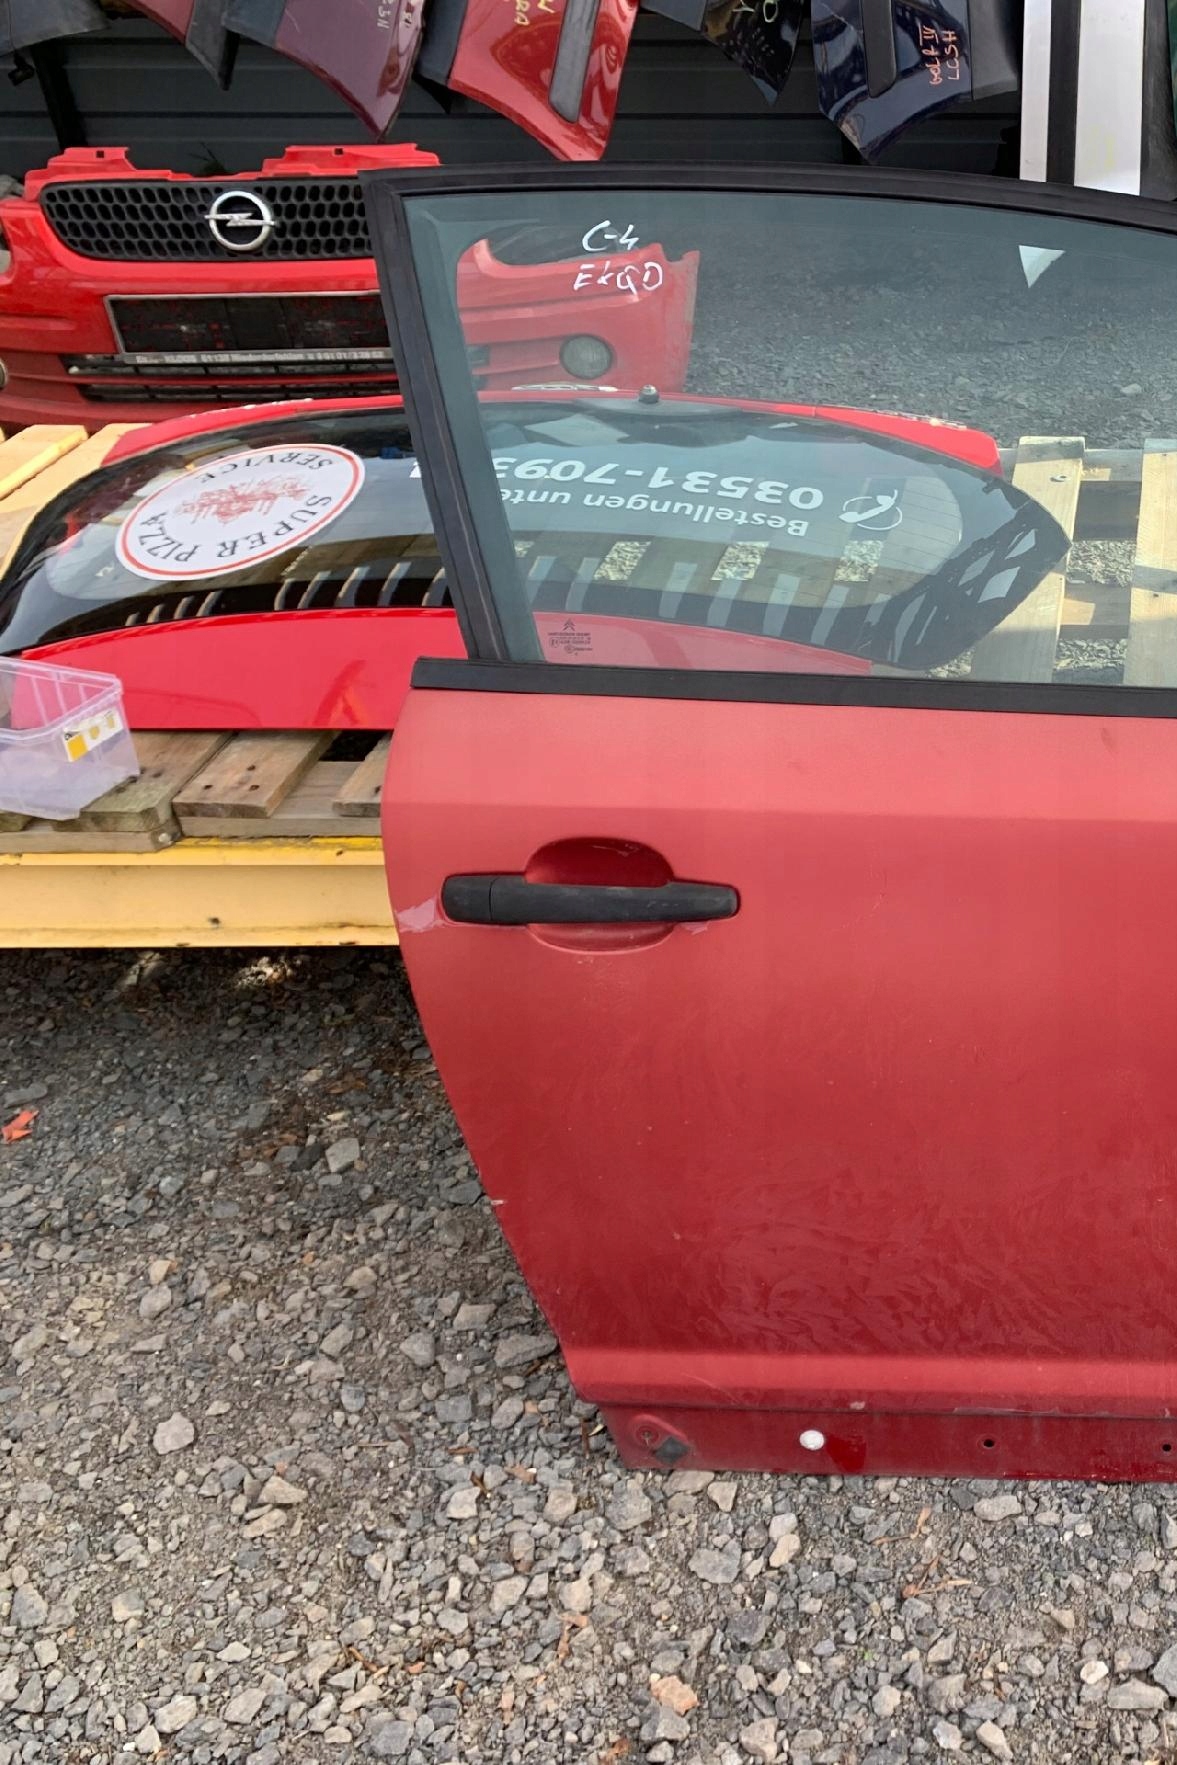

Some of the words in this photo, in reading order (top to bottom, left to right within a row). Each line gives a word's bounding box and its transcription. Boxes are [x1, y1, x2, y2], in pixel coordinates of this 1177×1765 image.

[581, 220, 640, 252] C-4
[194, 452, 334, 484] SERVICE
[409, 457, 824, 510] 03531-7093
[499, 488, 572, 507] unte
[583, 493, 809, 537] Bestellungen
[138, 511, 201, 562] PIZZA
[216, 494, 332, 559] SUPER
